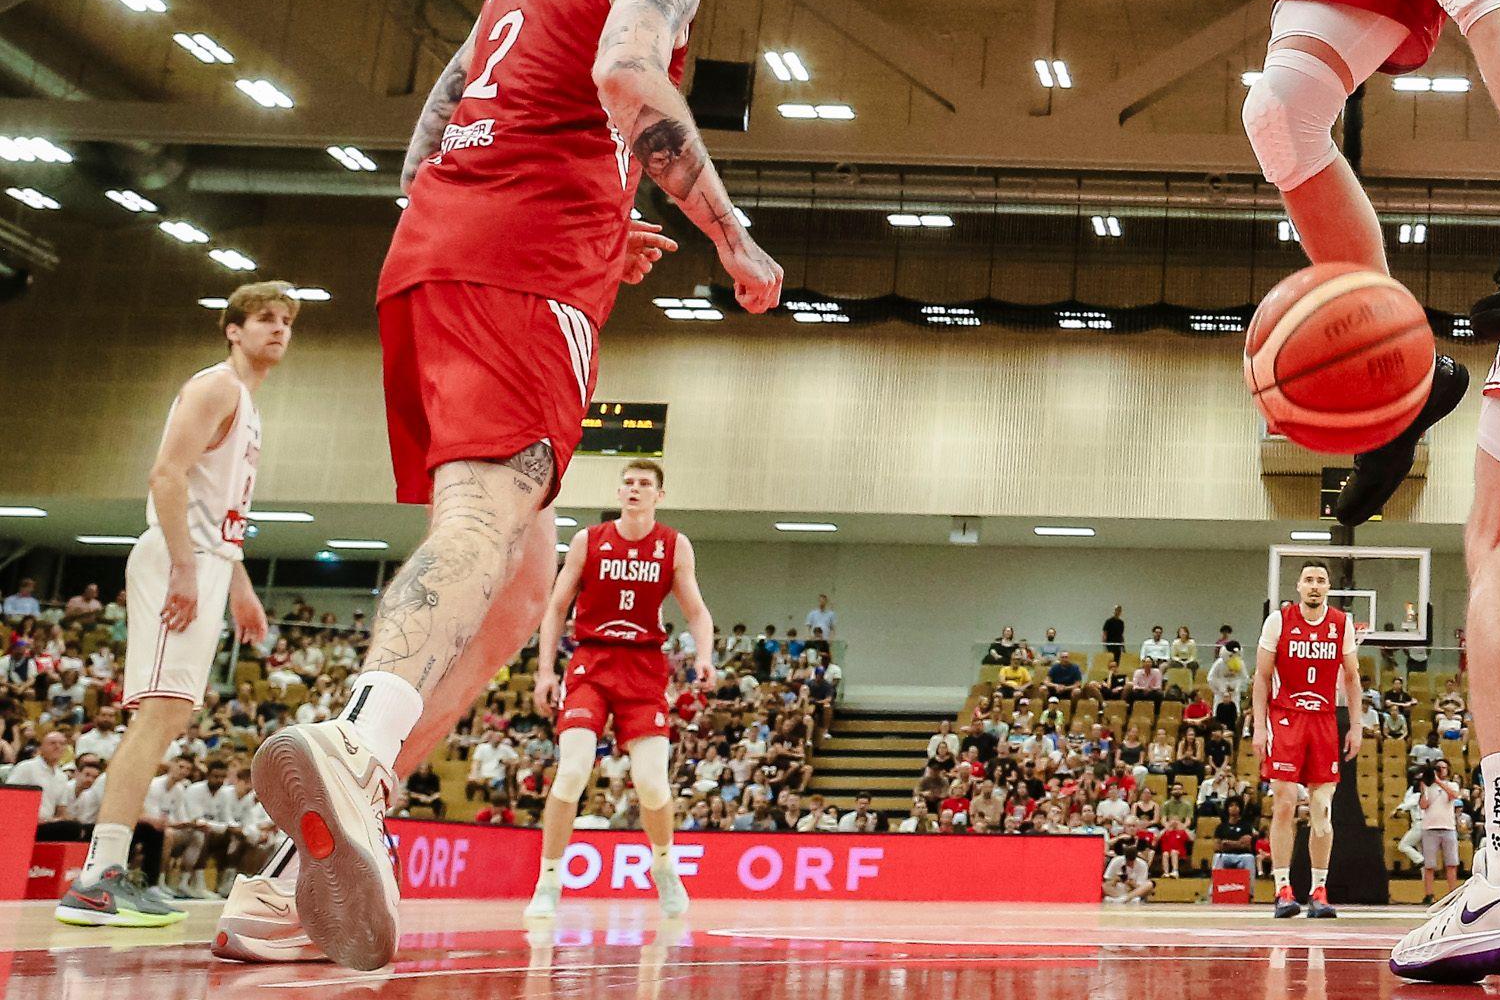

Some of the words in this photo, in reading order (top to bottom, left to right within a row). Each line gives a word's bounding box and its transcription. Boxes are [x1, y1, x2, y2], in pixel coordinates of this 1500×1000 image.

[461, 9, 525, 99] 2
[599, 558, 661, 583] POLSKA
[619, 589, 636, 611] 13
[1288, 640, 1337, 660] POLSKA
[1307, 666, 1316, 684] 0
[1295, 699, 1322, 711] PGE
[407, 836, 470, 888] ORF
[737, 844, 885, 892] ORF
